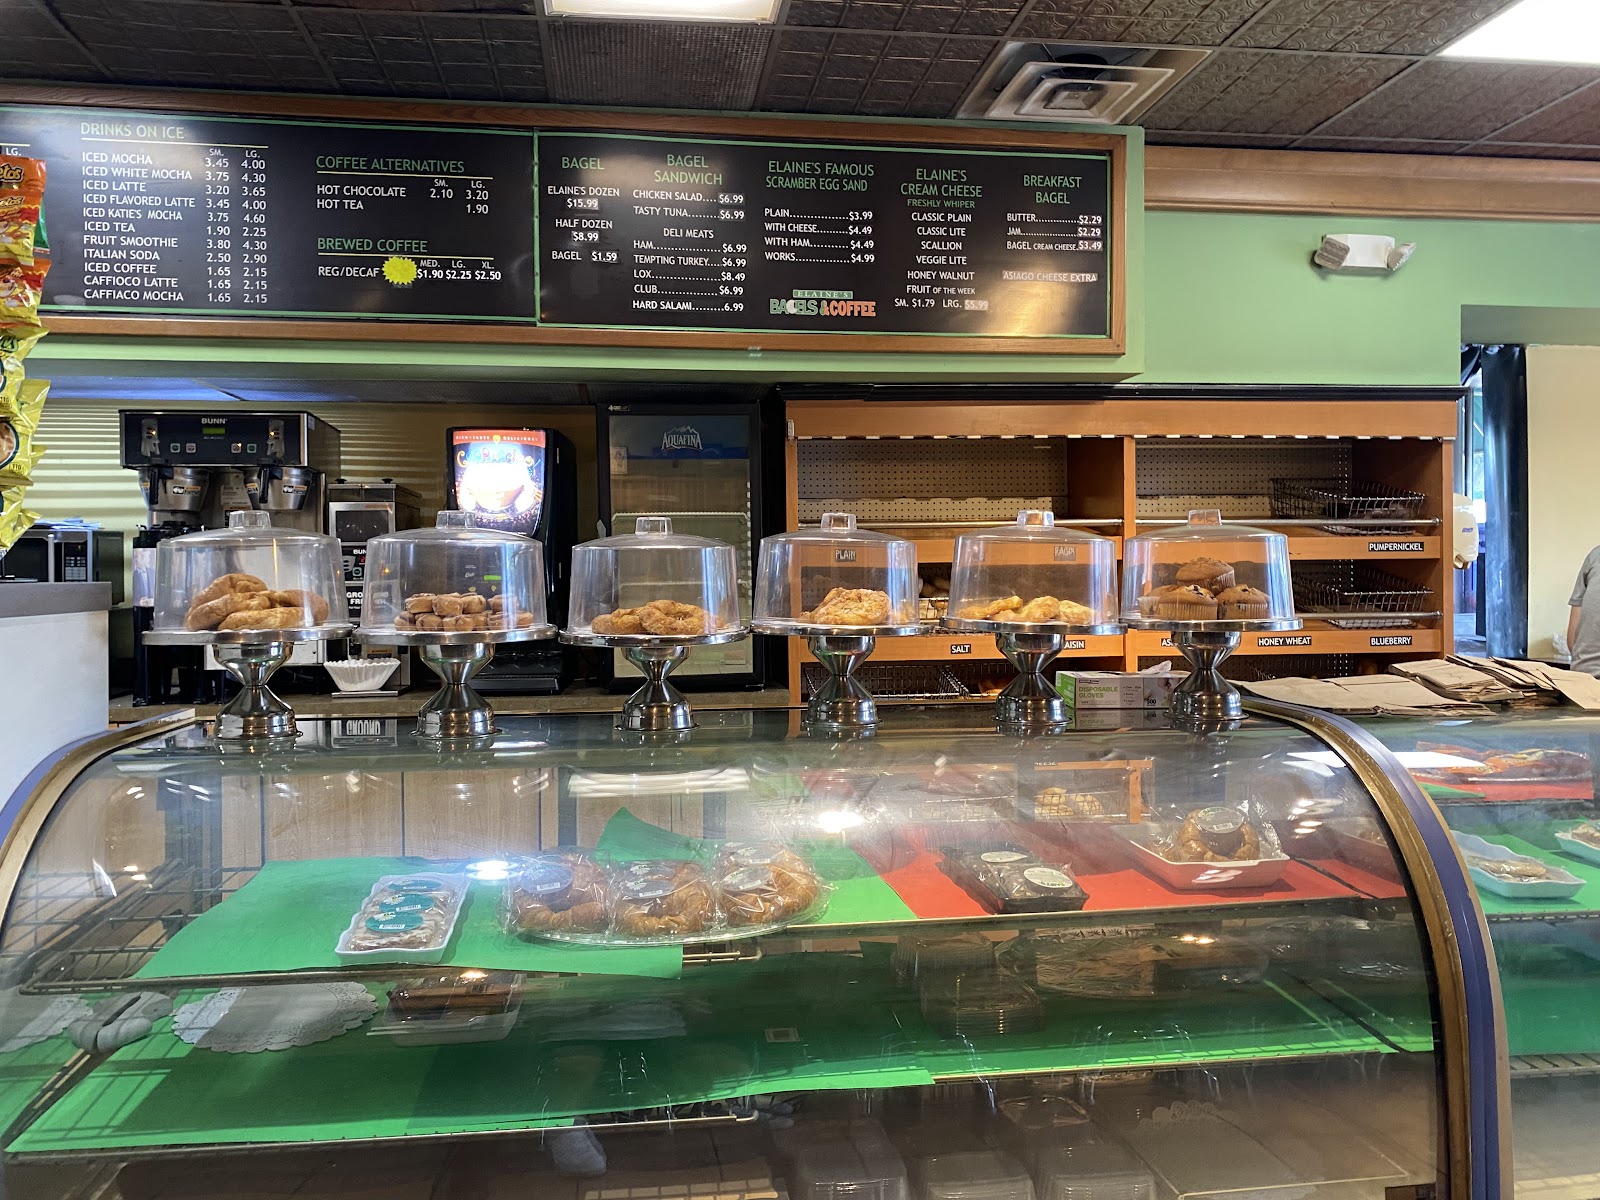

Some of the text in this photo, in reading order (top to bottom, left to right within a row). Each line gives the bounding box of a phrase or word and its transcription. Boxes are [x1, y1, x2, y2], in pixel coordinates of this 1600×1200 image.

[80, 122, 184, 139] DRINKS ON ICE
[82, 152, 265, 169] ICED MOCHA 3.45 4.00
[316, 156, 464, 173] COFFEE ALTERNATIVES
[562, 157, 604, 170] BAGEL
[667, 154, 708, 168] BAGEL
[82, 166, 266, 183] ICED WHITE MOCHA 3.75 4.30
[768, 161, 874, 176] ELAINE'S FAMOUS
[916, 168, 967, 181] ELAINE'S
[654, 170, 722, 185] SANDWICH
[766, 176, 868, 191] SCRAMBER EGG SAND
[1023, 175, 1082, 188] BREAKFAST
[83, 180, 266, 196] ICED LATTE 3.20 3.65
[317, 185, 489, 200] HOT CHOCOLATE 2.10 3.20
[589, 187, 620, 196] DOZEN
[901, 183, 982, 197] CREAM CHEESE
[83, 194, 266, 210] ICED FLAVORED LATTE 3.45 4.00
[633, 190, 672, 200] CHICKEN
[719, 194, 744, 204] $6.99
[1036, 192, 1070, 204] BAGEL
[317, 199, 489, 214] HOT TEA 1.90
[567, 198, 598, 209] $15.99
[907, 199, 975, 208] FRESHLY WHIPER
[83, 207, 105, 217] ICED
[148, 210, 182, 220] MOCHA
[208, 213, 228, 222] 3.75
[244, 214, 265, 223] 4.60
[633, 206, 661, 216] TASTY
[720, 210, 744, 220] $6.99
[849, 211, 873, 221] $3.99
[911, 212, 972, 222] CLASSIC PLAIN
[556, 219, 612, 229] HALF DOZEN
[1079, 215, 1102, 224] $2.29
[84, 222, 266, 237] ICED TEA 1.90 2.25
[663, 228, 714, 238] DELI MEATS
[764, 223, 786, 231] WITH
[849, 226, 872, 235] $4.49
[917, 227, 966, 236] CLASSIC LITE
[1078, 227, 1100, 237] $2.29
[573, 231, 599, 241] $8.99
[84, 235, 267, 250] FRUIT SMOOTHIE 3.80 4.30
[318, 238, 428, 252] BREWED COFFEE
[722, 244, 747, 253] $6.99
[764, 237, 788, 246] WITH
[850, 240, 874, 249] $4.49
[921, 241, 962, 250] SCALLION
[1007, 241, 1102, 250] BAGEL $3.49
[84, 249, 267, 264] ITALIAN SODA 2.50 2.90
[552, 251, 617, 262] BAGEL $1.59
[634, 255, 675, 265] TEMPTING
[851, 254, 874, 263] $4.99
[916, 255, 967, 265] VEGGIE LITE
[84, 262, 267, 277] ICED COFFEE 1.65 2.15
[318, 266, 501, 281] REG/DECAF $1.90 $2.25 $2.50
[907, 271, 974, 280] HONEY WALNUT
[84, 276, 267, 290] CAFFIOCO LATTE 1.65 2.15
[721, 272, 746, 282] $8.49
[1003, 272, 1097, 282] ASIAGO CHEESE EXTRA
[719, 286, 744, 295] $6.99
[907, 285, 931, 294] FRUIT
[84, 289, 267, 304] CAFFIACO MOCHA 1.65 2.15
[633, 300, 658, 309] HARD
[724, 303, 744, 311] 6.99
[895, 298, 962, 308] SM. $1.79 LRG.
[661, 432, 703, 450] AQUAFINA
[1368, 542, 1422, 552] PUMPERNICKEL
[836, 550, 856, 560] PLAIN
[1258, 637, 1311, 646] HONEY WHEAT
[1370, 636, 1410, 646] BLUEBERRY
[951, 645, 970, 653] SALT
